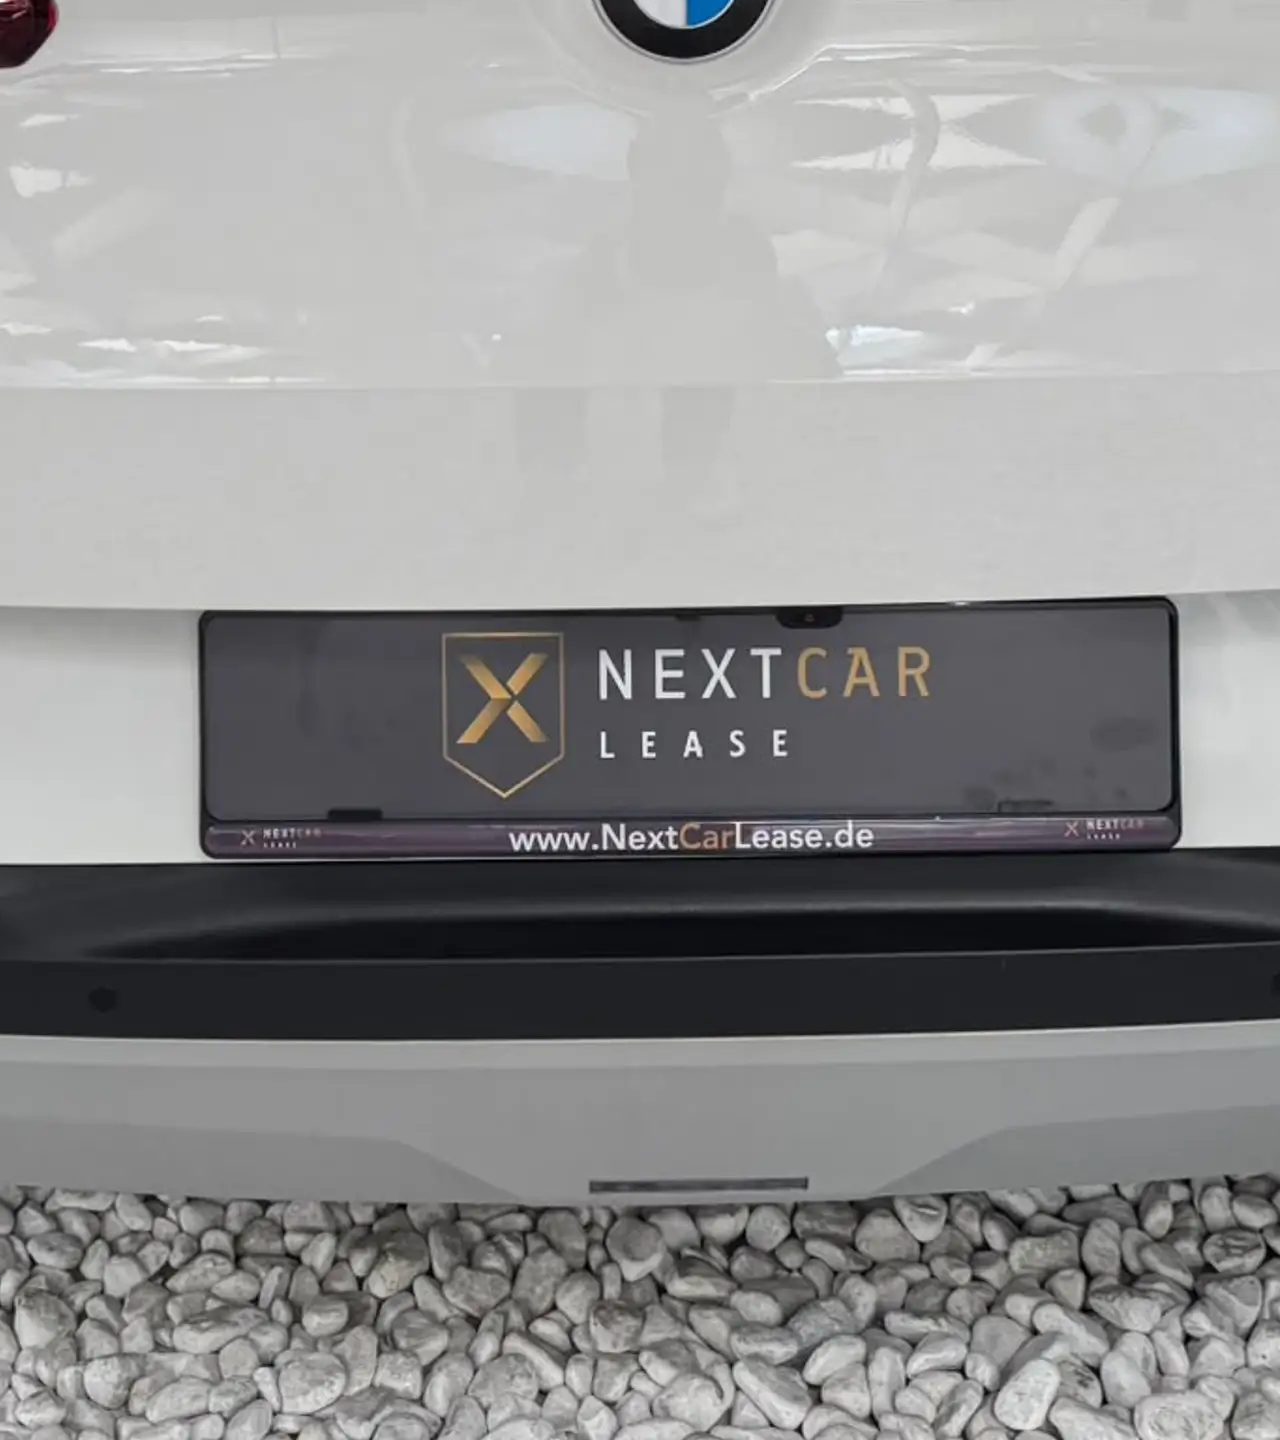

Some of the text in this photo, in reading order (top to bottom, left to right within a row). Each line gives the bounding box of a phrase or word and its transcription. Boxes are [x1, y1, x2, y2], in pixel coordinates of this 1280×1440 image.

[598, 646, 932, 701] NEXTCAR
[599, 728, 790, 760] LEASE
[508, 820, 875, 853] www.NextCarLease.de
